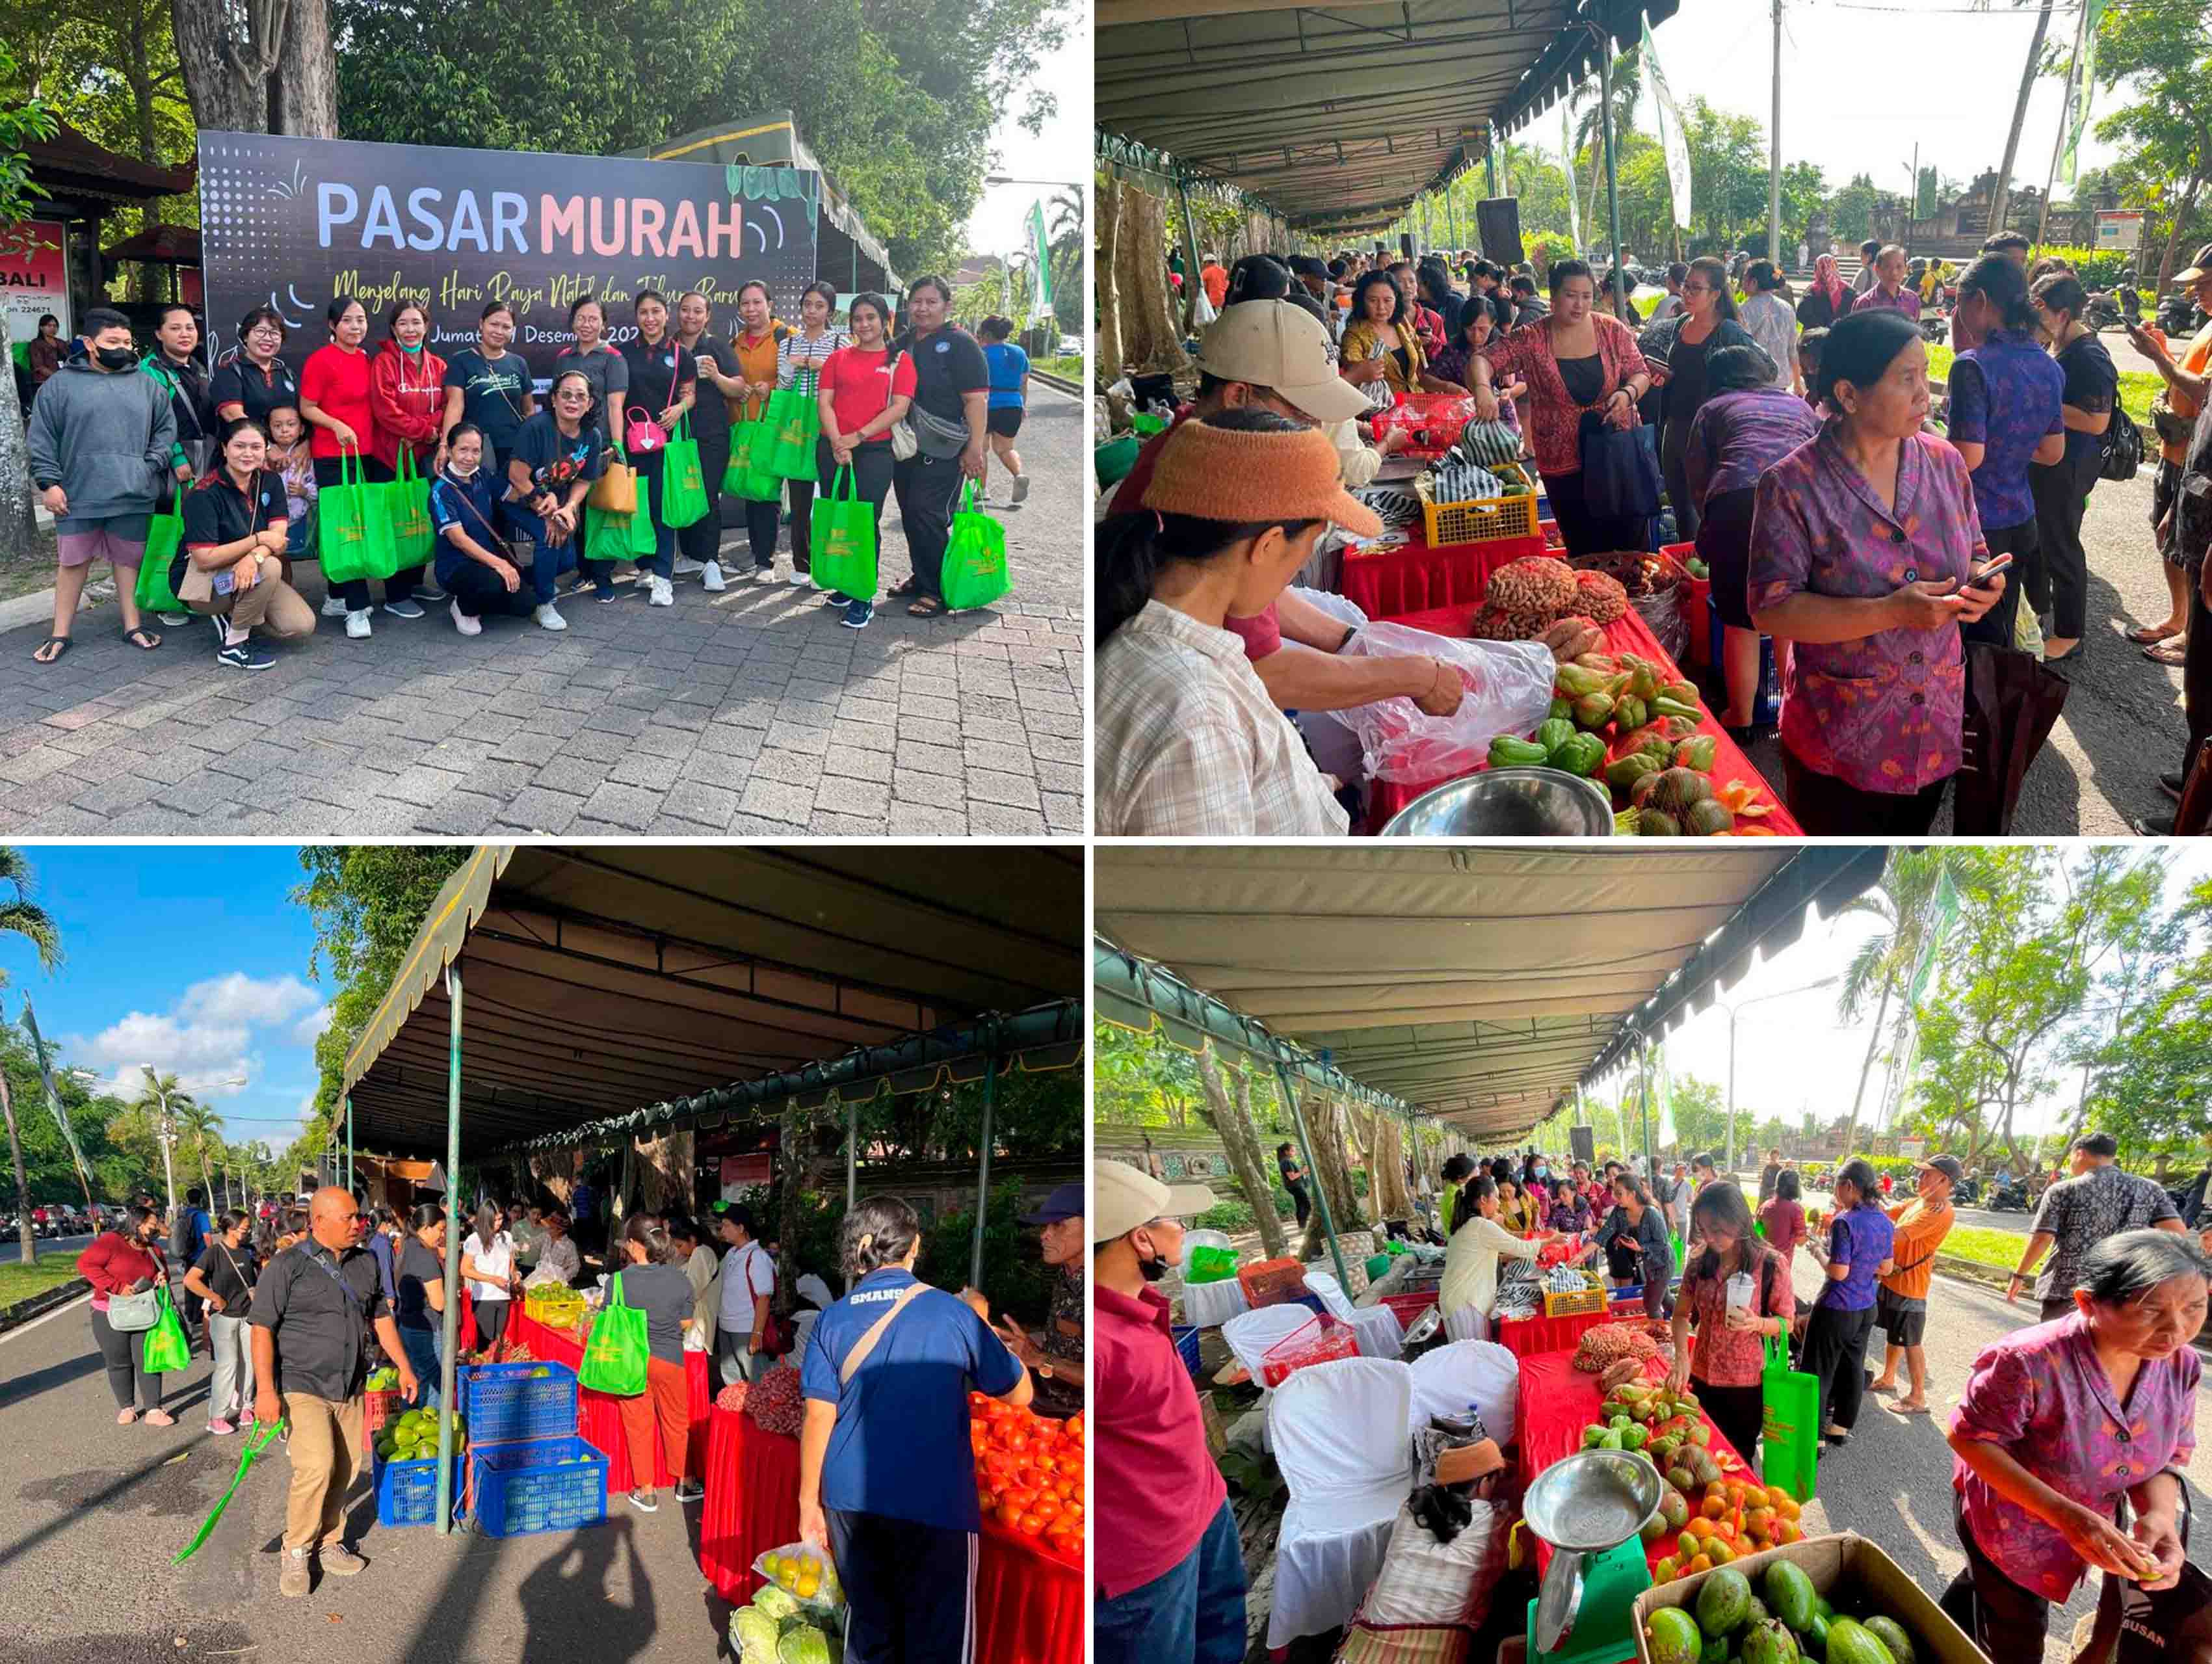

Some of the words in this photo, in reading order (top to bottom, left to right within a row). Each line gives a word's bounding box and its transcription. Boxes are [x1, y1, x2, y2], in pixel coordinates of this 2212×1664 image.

[317, 182, 529, 254] PASAR
[540, 194, 741, 258] MURAH
[439, 270, 483, 311] Hari
[487, 271, 542, 314] Raya
[525, 325, 577, 343] Desem
[850, 1288, 906, 1305] SMANS
